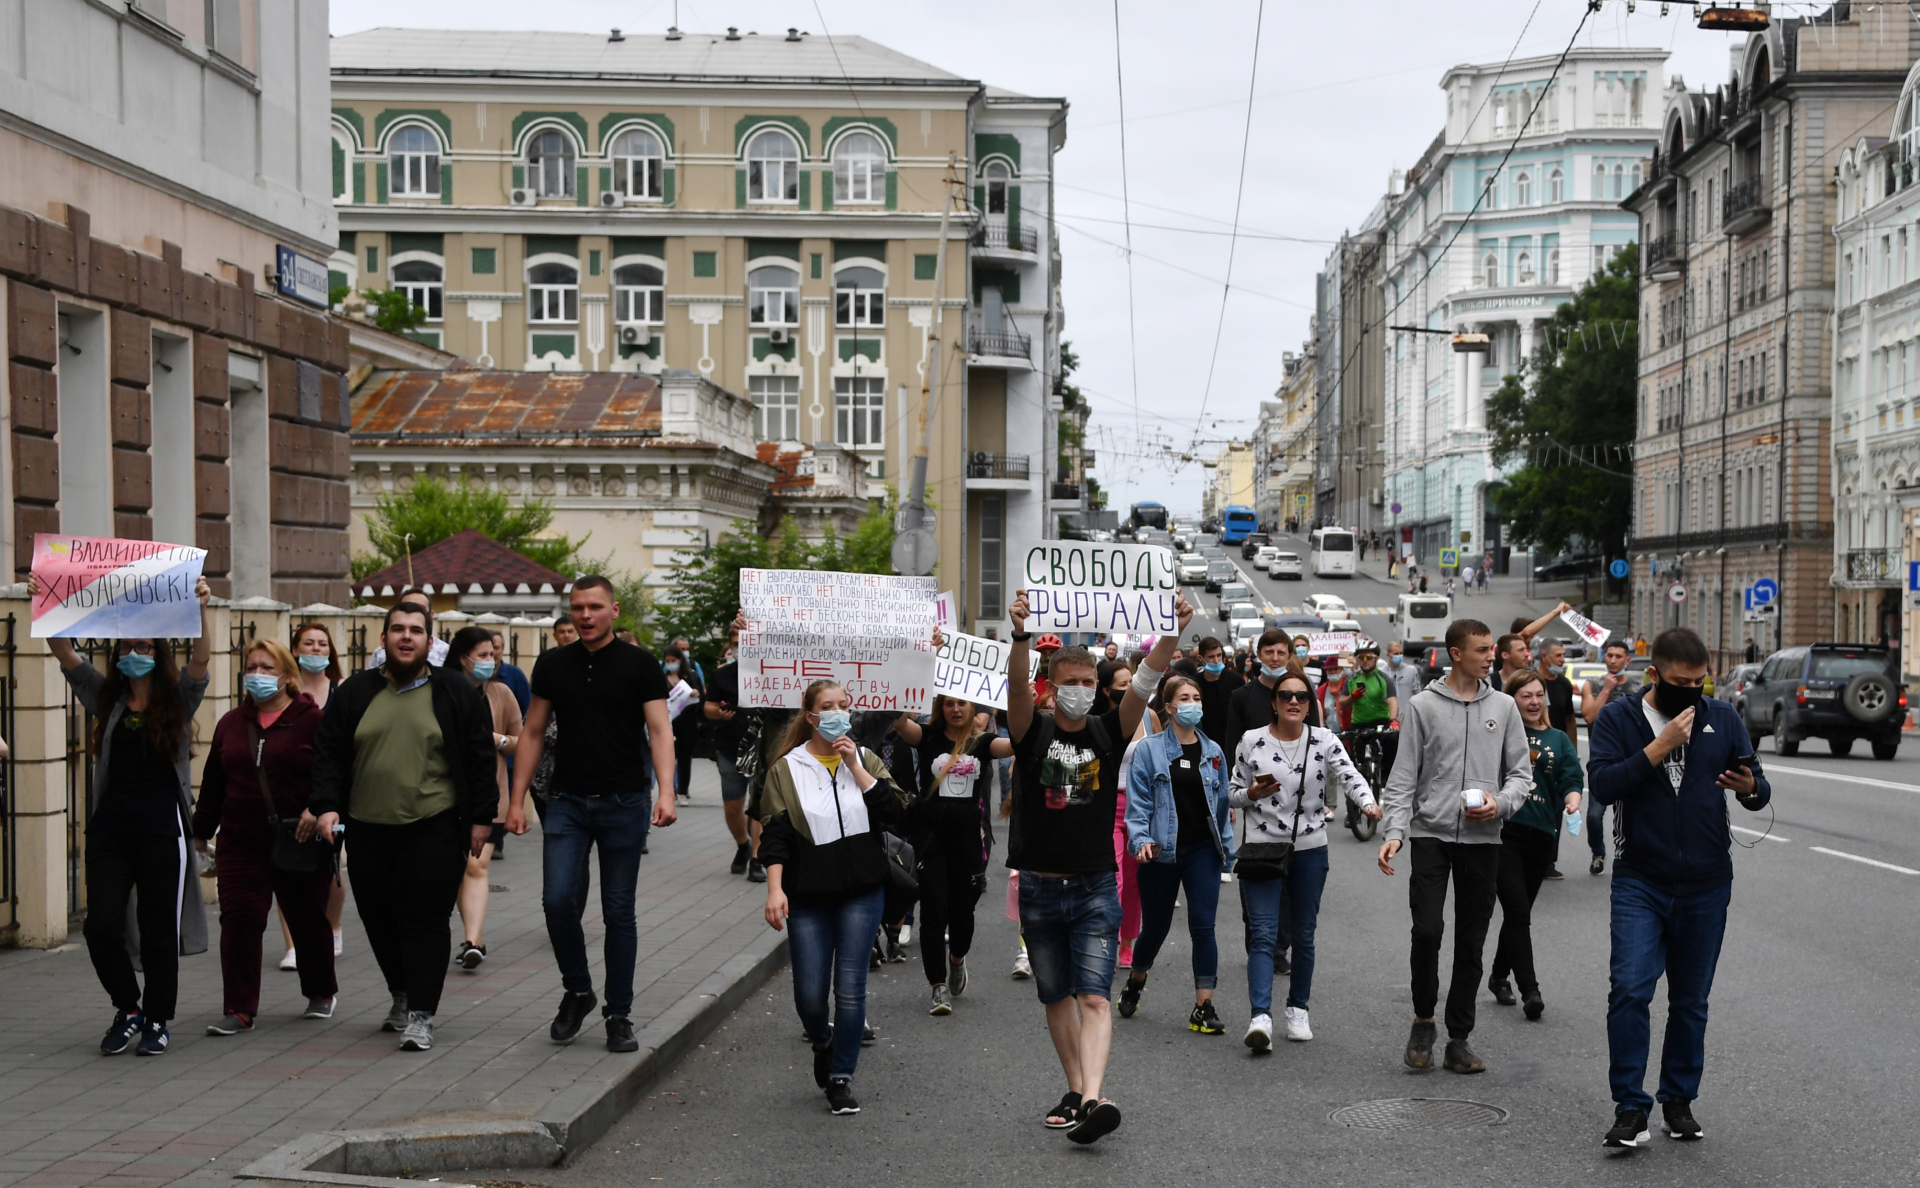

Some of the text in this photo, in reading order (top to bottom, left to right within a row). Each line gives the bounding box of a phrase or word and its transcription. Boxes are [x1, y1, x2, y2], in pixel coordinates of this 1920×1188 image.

[282, 253, 295, 289] 54
[69, 539, 200, 563] ВЛАДИВОСТОК
[1027, 546, 1175, 591] СВОБОДУ
[742, 570, 937, 589] НЕТ ВЫРУБЛЕННЫМ ЛЕСАМ НЕТ ПОВЫШЕНИЮ
[38, 572, 189, 608] ХАБАРОВСК!
[741, 584, 759, 595] ЦЕН
[817, 585, 834, 597] НЕТ
[840, 586, 900, 600] ПОВЫШЕНИЮ
[904, 589, 937, 603] ТАРИФОВ
[742, 596, 928, 612] ЖКХ НЕТ ПОВЫШЕНИЮ ПЕНСИОННОГО
[1026, 589, 1175, 632] ФУРГАЛУ
[793, 609, 814, 621] НЕТ
[818, 609, 888, 623] БЕСКОНЕЧНЫМ
[746, 621, 925, 637] ЕТ РАЗВАЛУ СИСТЕМЫ ОБРАЗОВАНИЯ
[742, 634, 934, 653] НЕТ ПОПРАВКАМ КОНСТИТУЦИИ НЕТ
[741, 647, 806, 660] ОБНУЛЕНИЮ
[811, 648, 846, 661] СРОКОВ
[760, 659, 882, 678] НЕТ
[743, 677, 890, 693] ИЗДЕВАТСТВУ
[750, 694, 786, 707] НАД
[1047, 748, 1092, 765] MOVEMENT
